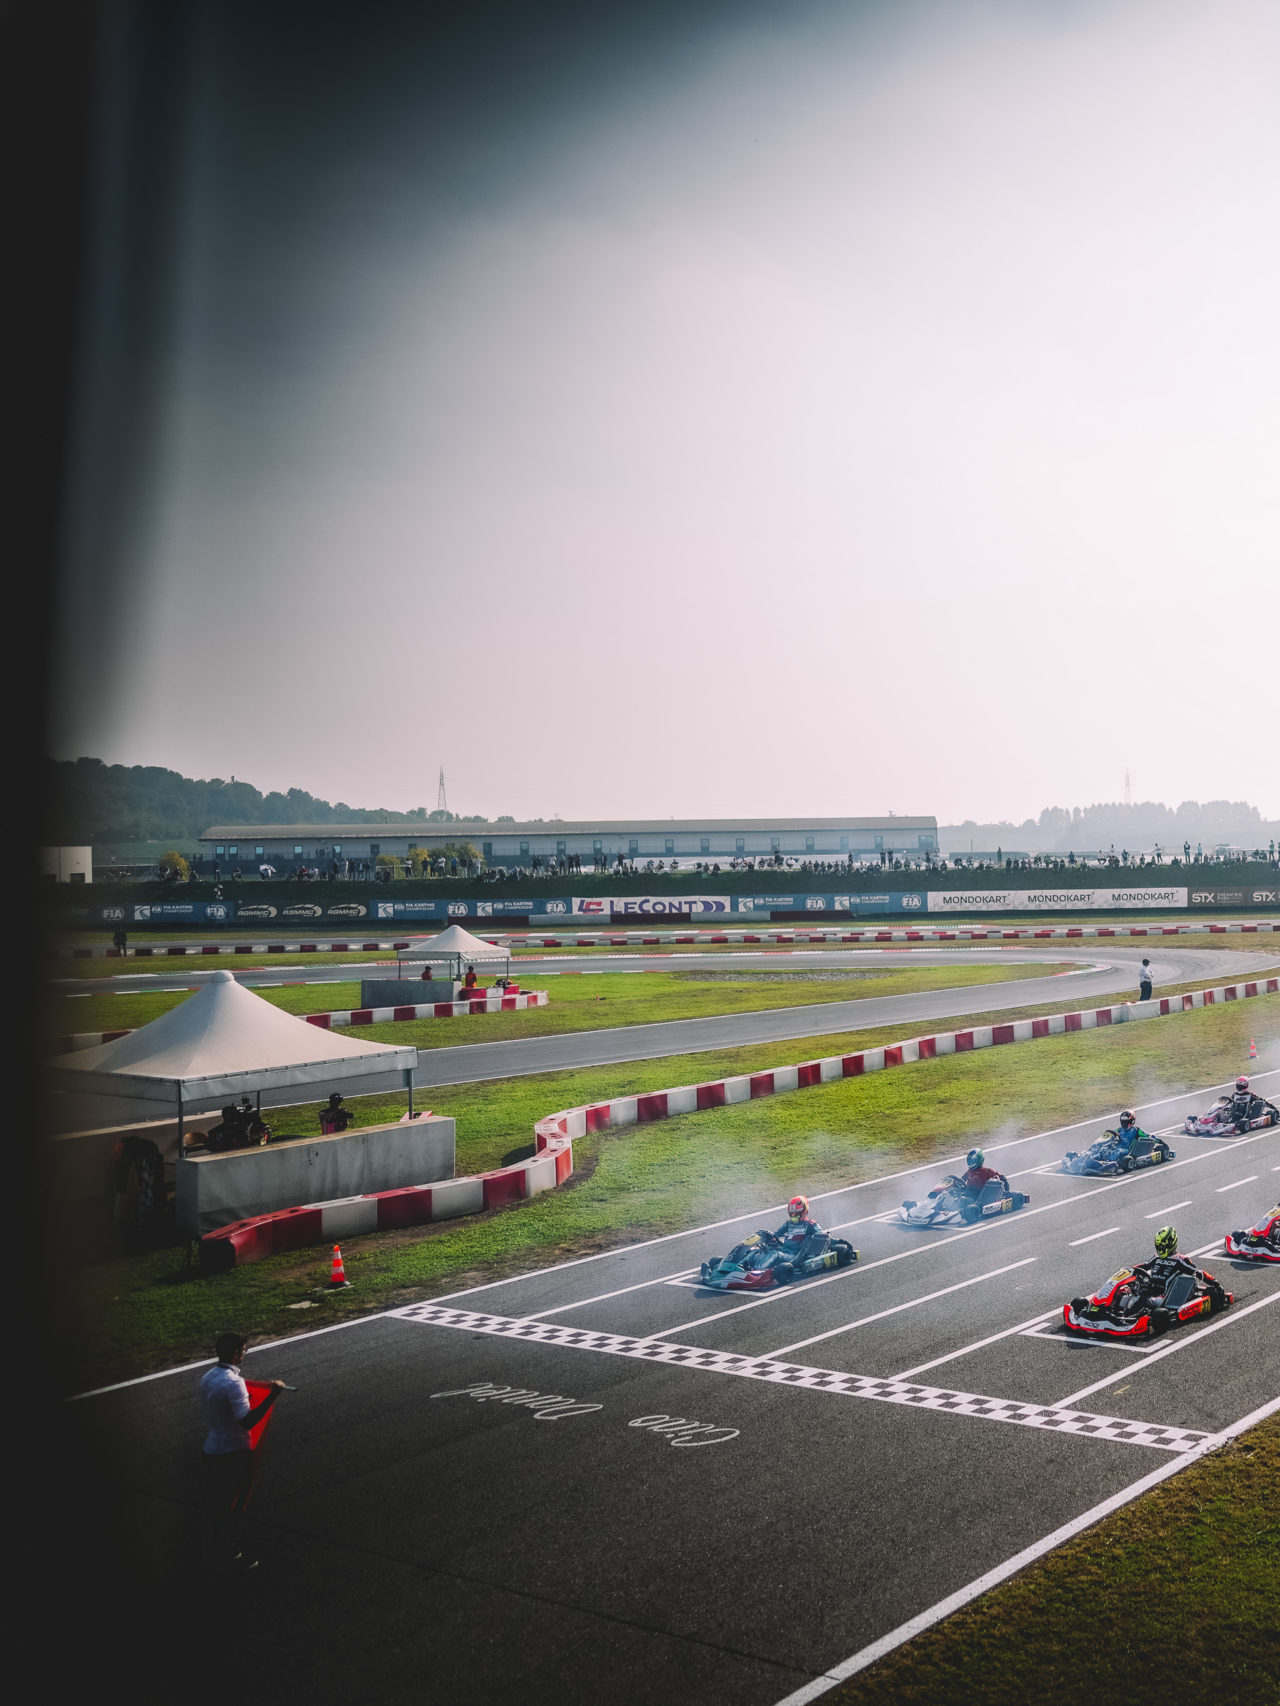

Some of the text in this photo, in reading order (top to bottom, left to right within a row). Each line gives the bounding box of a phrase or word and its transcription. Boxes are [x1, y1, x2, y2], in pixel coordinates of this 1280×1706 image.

[903, 896, 920, 908] FIA
[943, 896, 1007, 904] MONDOKART
[1027, 894, 1092, 903] MONDOKART
[1112, 892, 1175, 901] MONDOKART
[1192, 892, 1215, 903] STX
[1252, 891, 1276, 902] STX
[448, 904, 467, 915] FIA
[547, 902, 565, 913] FIA
[807, 898, 825, 910] FIA
[103, 908, 123, 920] FIA
[207, 906, 226, 918] FIA
[430, 1382, 741, 1447] Ciao Daniel
